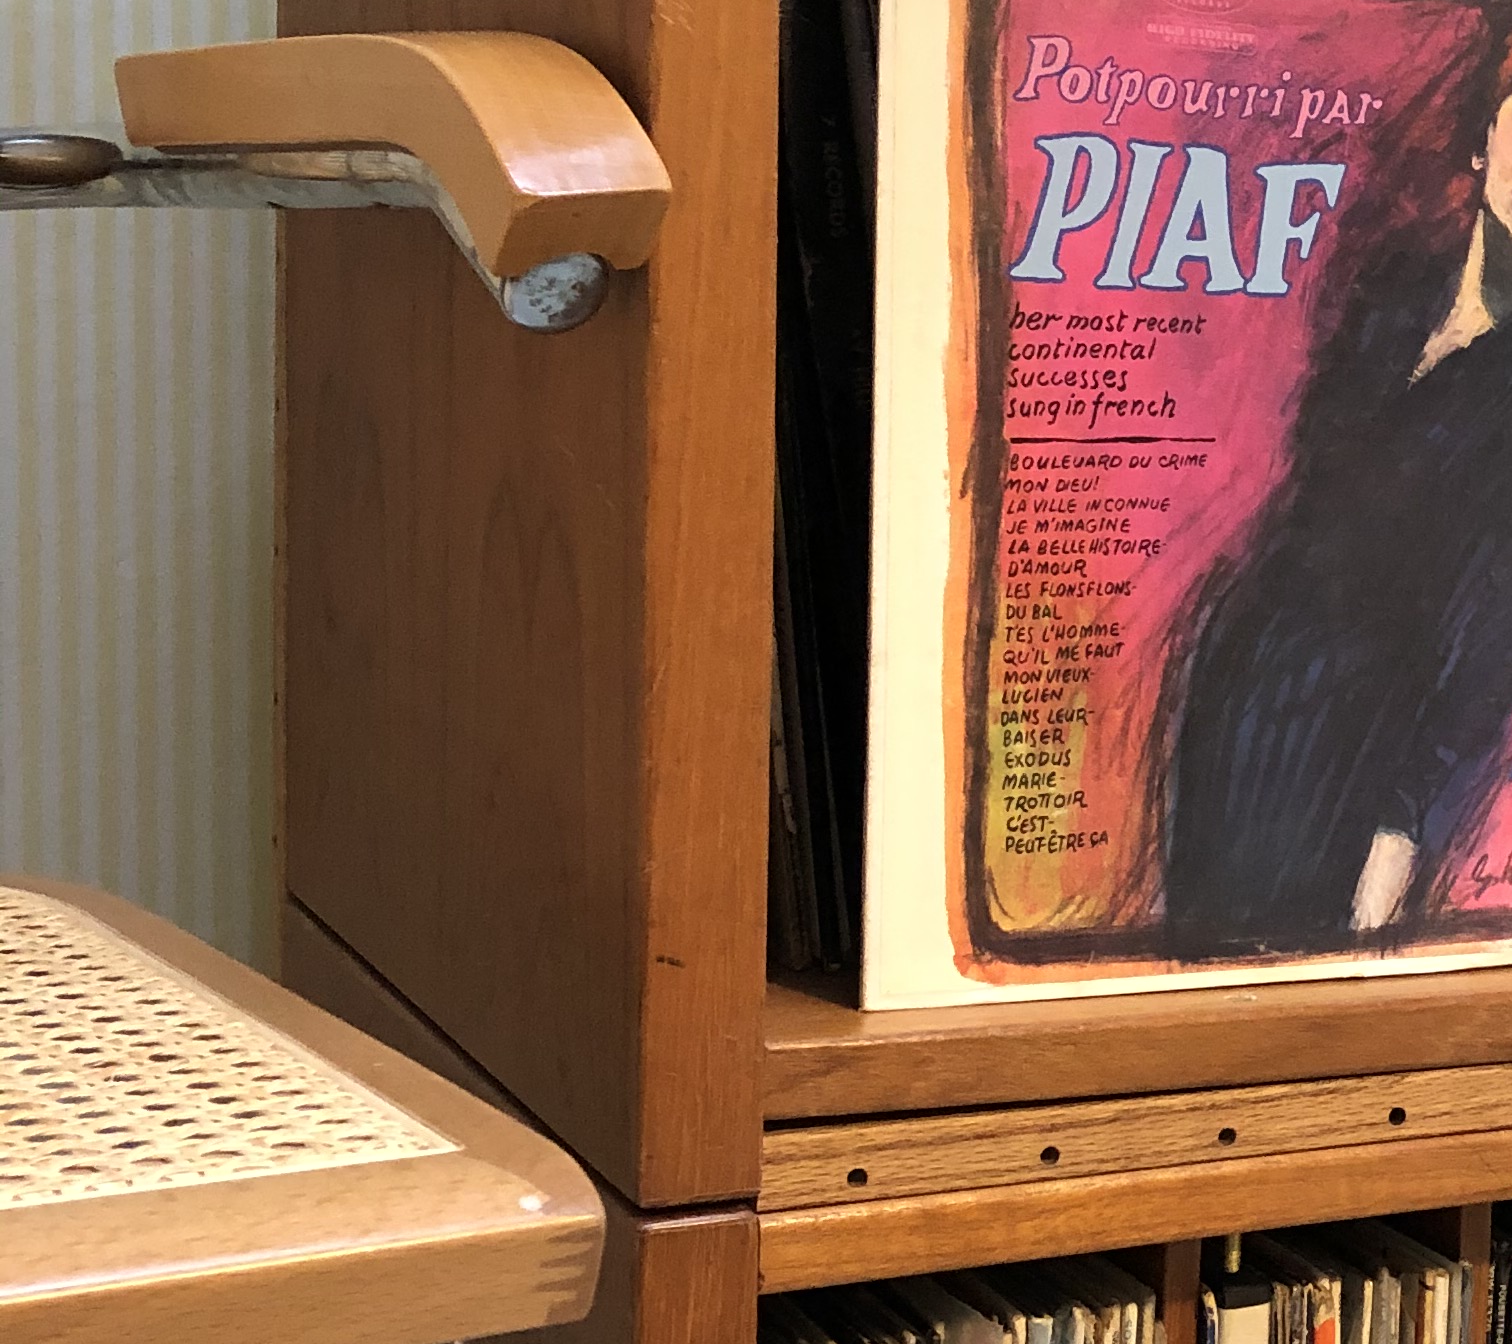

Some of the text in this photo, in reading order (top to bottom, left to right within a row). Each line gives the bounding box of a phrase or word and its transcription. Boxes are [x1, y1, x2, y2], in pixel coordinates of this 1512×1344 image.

[1014, 34, 1292, 126] Potpourri
[1007, 131, 1346, 299] PIAF
[1009, 301, 1207, 335] her most recent
[1007, 337, 1156, 361] continental
[1007, 367, 1128, 392] successes
[1007, 390, 1176, 430] sung in french
[1010, 453, 1208, 471] BOULEVARD DU CRIME
[1005, 476, 1099, 493] MON DIEU!
[1007, 499, 1026, 515] LA
[1034, 498, 1077, 513] VILLE
[1006, 517, 1131, 535] JE M'IMAGINE
[1007, 539, 1030, 555] LA
[1037, 539, 1085, 556] BELLE
[1008, 558, 1088, 578] D'AMOUR
[1006, 582, 1031, 599] LES
[1006, 604, 1063, 620] DU BAL
[1005, 625, 1033, 644] T'ES
[1003, 642, 1125, 666] QU'IL ME FAUT
[1004, 669, 1042, 684] MON
[1002, 687, 1063, 704] LUCIEN
[1001, 709, 1039, 726] DANS
[1003, 728, 1065, 747] BAISER
[1005, 748, 1071, 768] EXODUS
[1004, 790, 1088, 812] TROTTOIR
